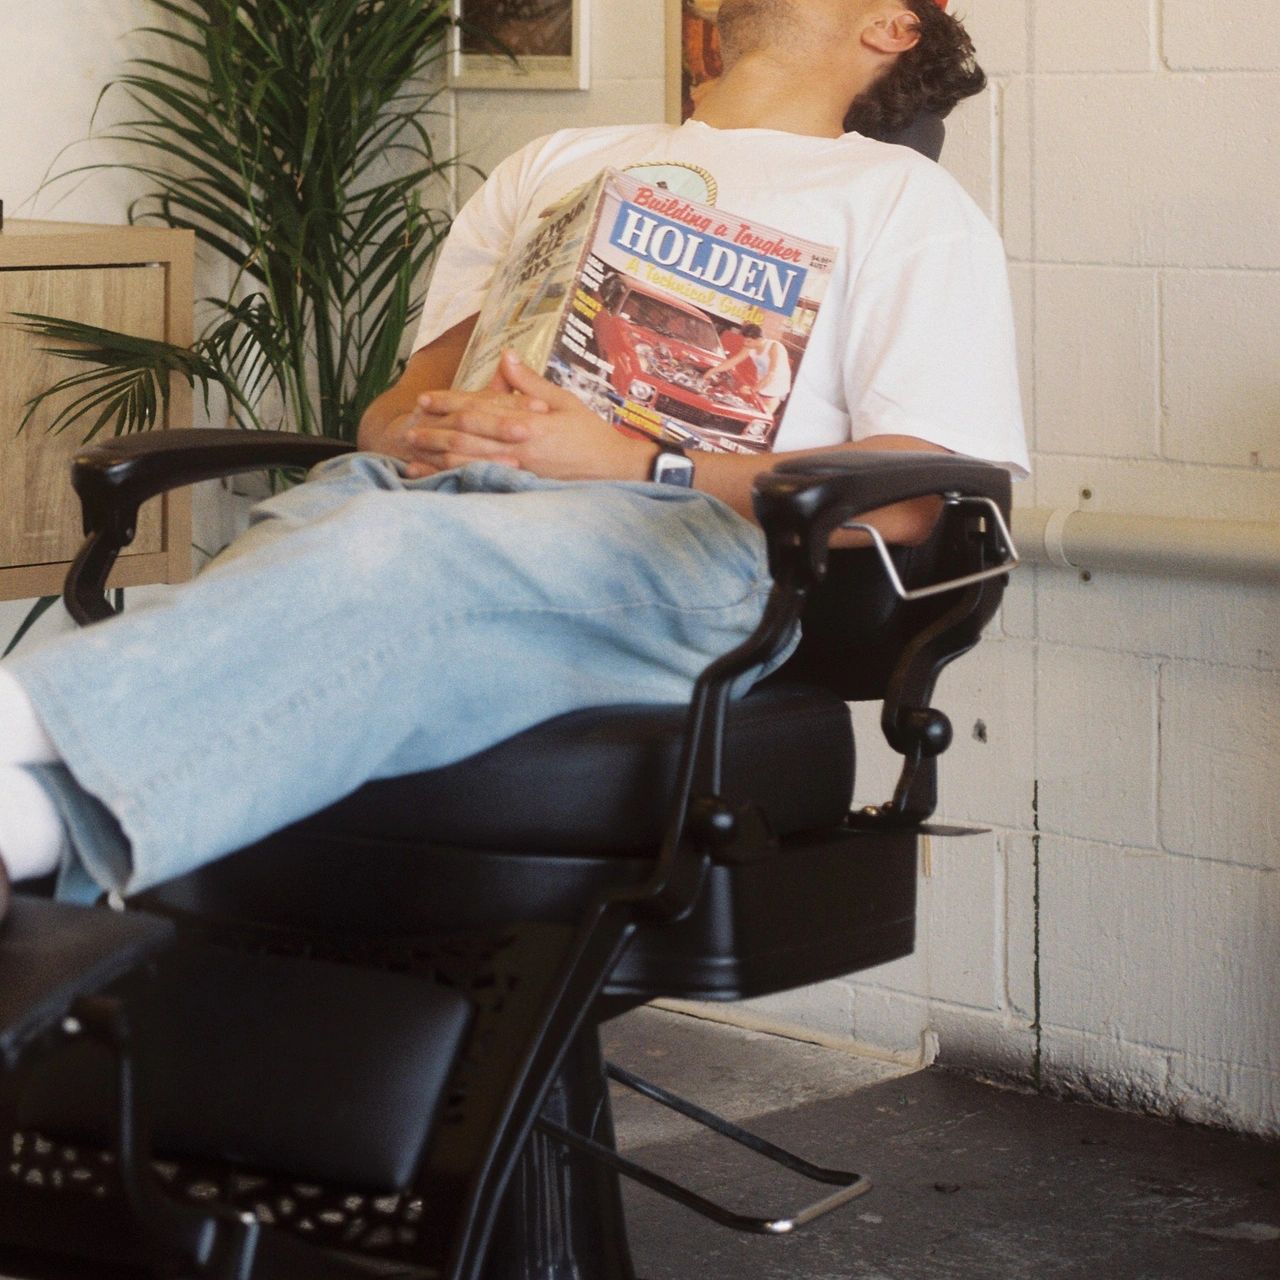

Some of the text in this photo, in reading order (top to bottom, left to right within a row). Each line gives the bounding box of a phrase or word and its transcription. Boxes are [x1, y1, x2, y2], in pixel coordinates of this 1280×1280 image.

[617, 209, 798, 309] HOLDEN
[633, 186, 803, 263] Building a Tougher
[625, 256, 766, 325] A Technical Guide
